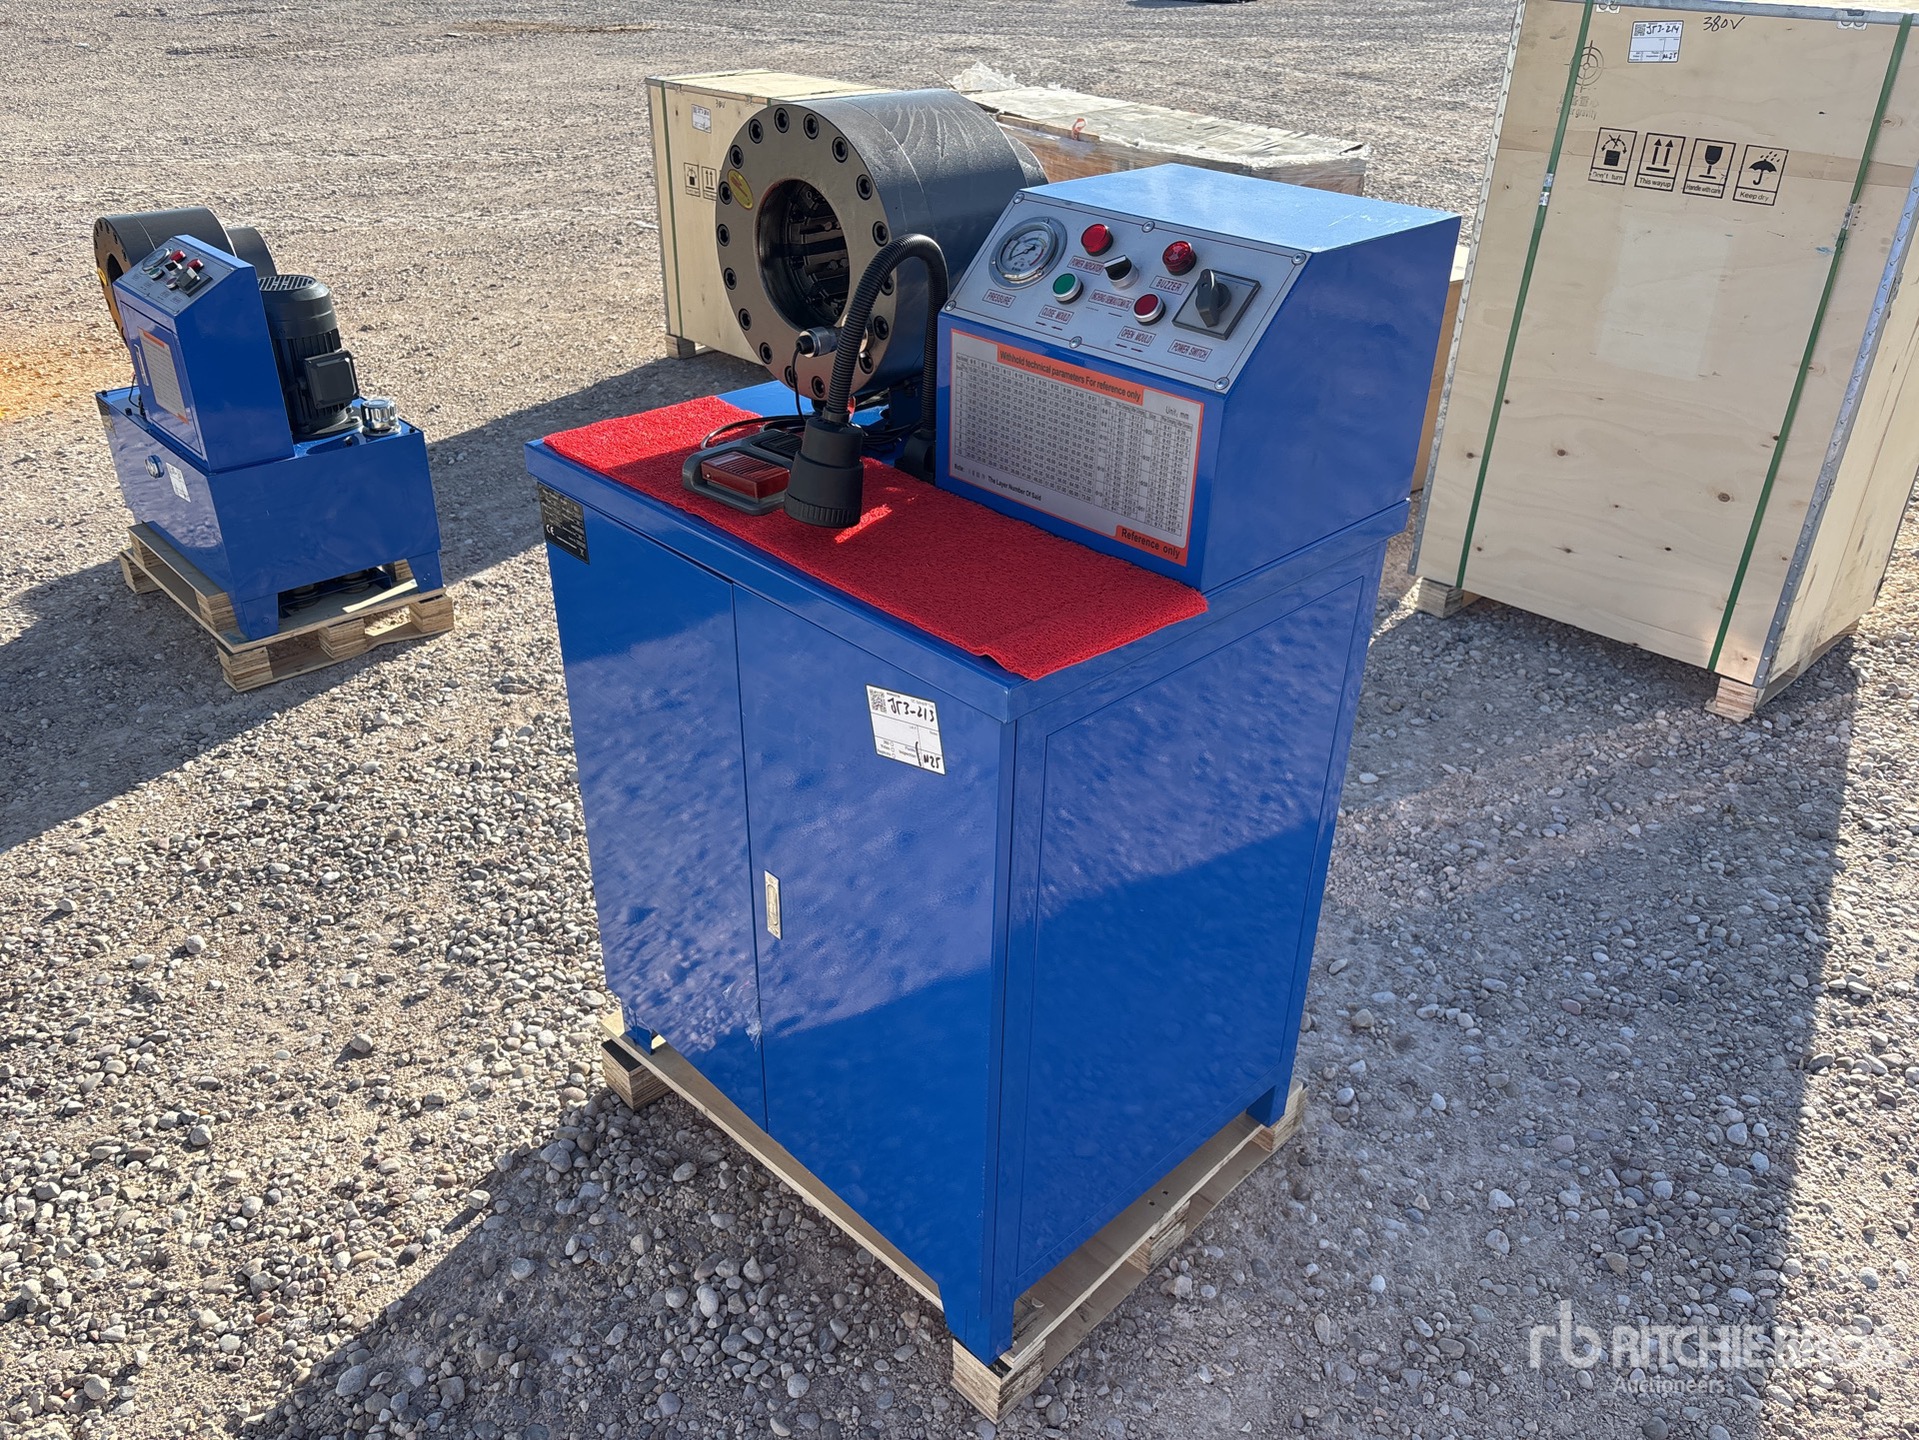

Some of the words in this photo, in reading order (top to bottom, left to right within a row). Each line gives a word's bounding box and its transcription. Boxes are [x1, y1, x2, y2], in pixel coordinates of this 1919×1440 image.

[1702, 15, 1746, 32] 380V
[1639, 176, 1651, 185] This
[1686, 184, 1702, 192] Handle
[1740, 191, 1757, 200] Keep
[1758, 193, 1770, 202] dry
[1156, 278, 1182, 292] BUZZER
[986, 290, 1012, 306] PRESSURE
[1041, 306, 1055, 318] CLOSE
[1056, 310, 1070, 322] MOULD
[1121, 328, 1134, 340] OPEN
[1134, 331, 1153, 344] MOULD
[1172, 342, 1190, 356] POWER
[1188, 346, 1208, 360] SWITCH
[1000, 350, 1025, 366] Withhold
[1025, 357, 1051, 373] technical
[1052, 364, 1085, 384] parameters
[1085, 376, 1096, 387] For
[1097, 380, 1125, 397] reference
[1126, 390, 1141, 402] only
[988, 476, 996, 484] The
[1008, 484, 1026, 495] Number
[1122, 528, 1160, 550] Reference
[1162, 544, 1180, 559] only
